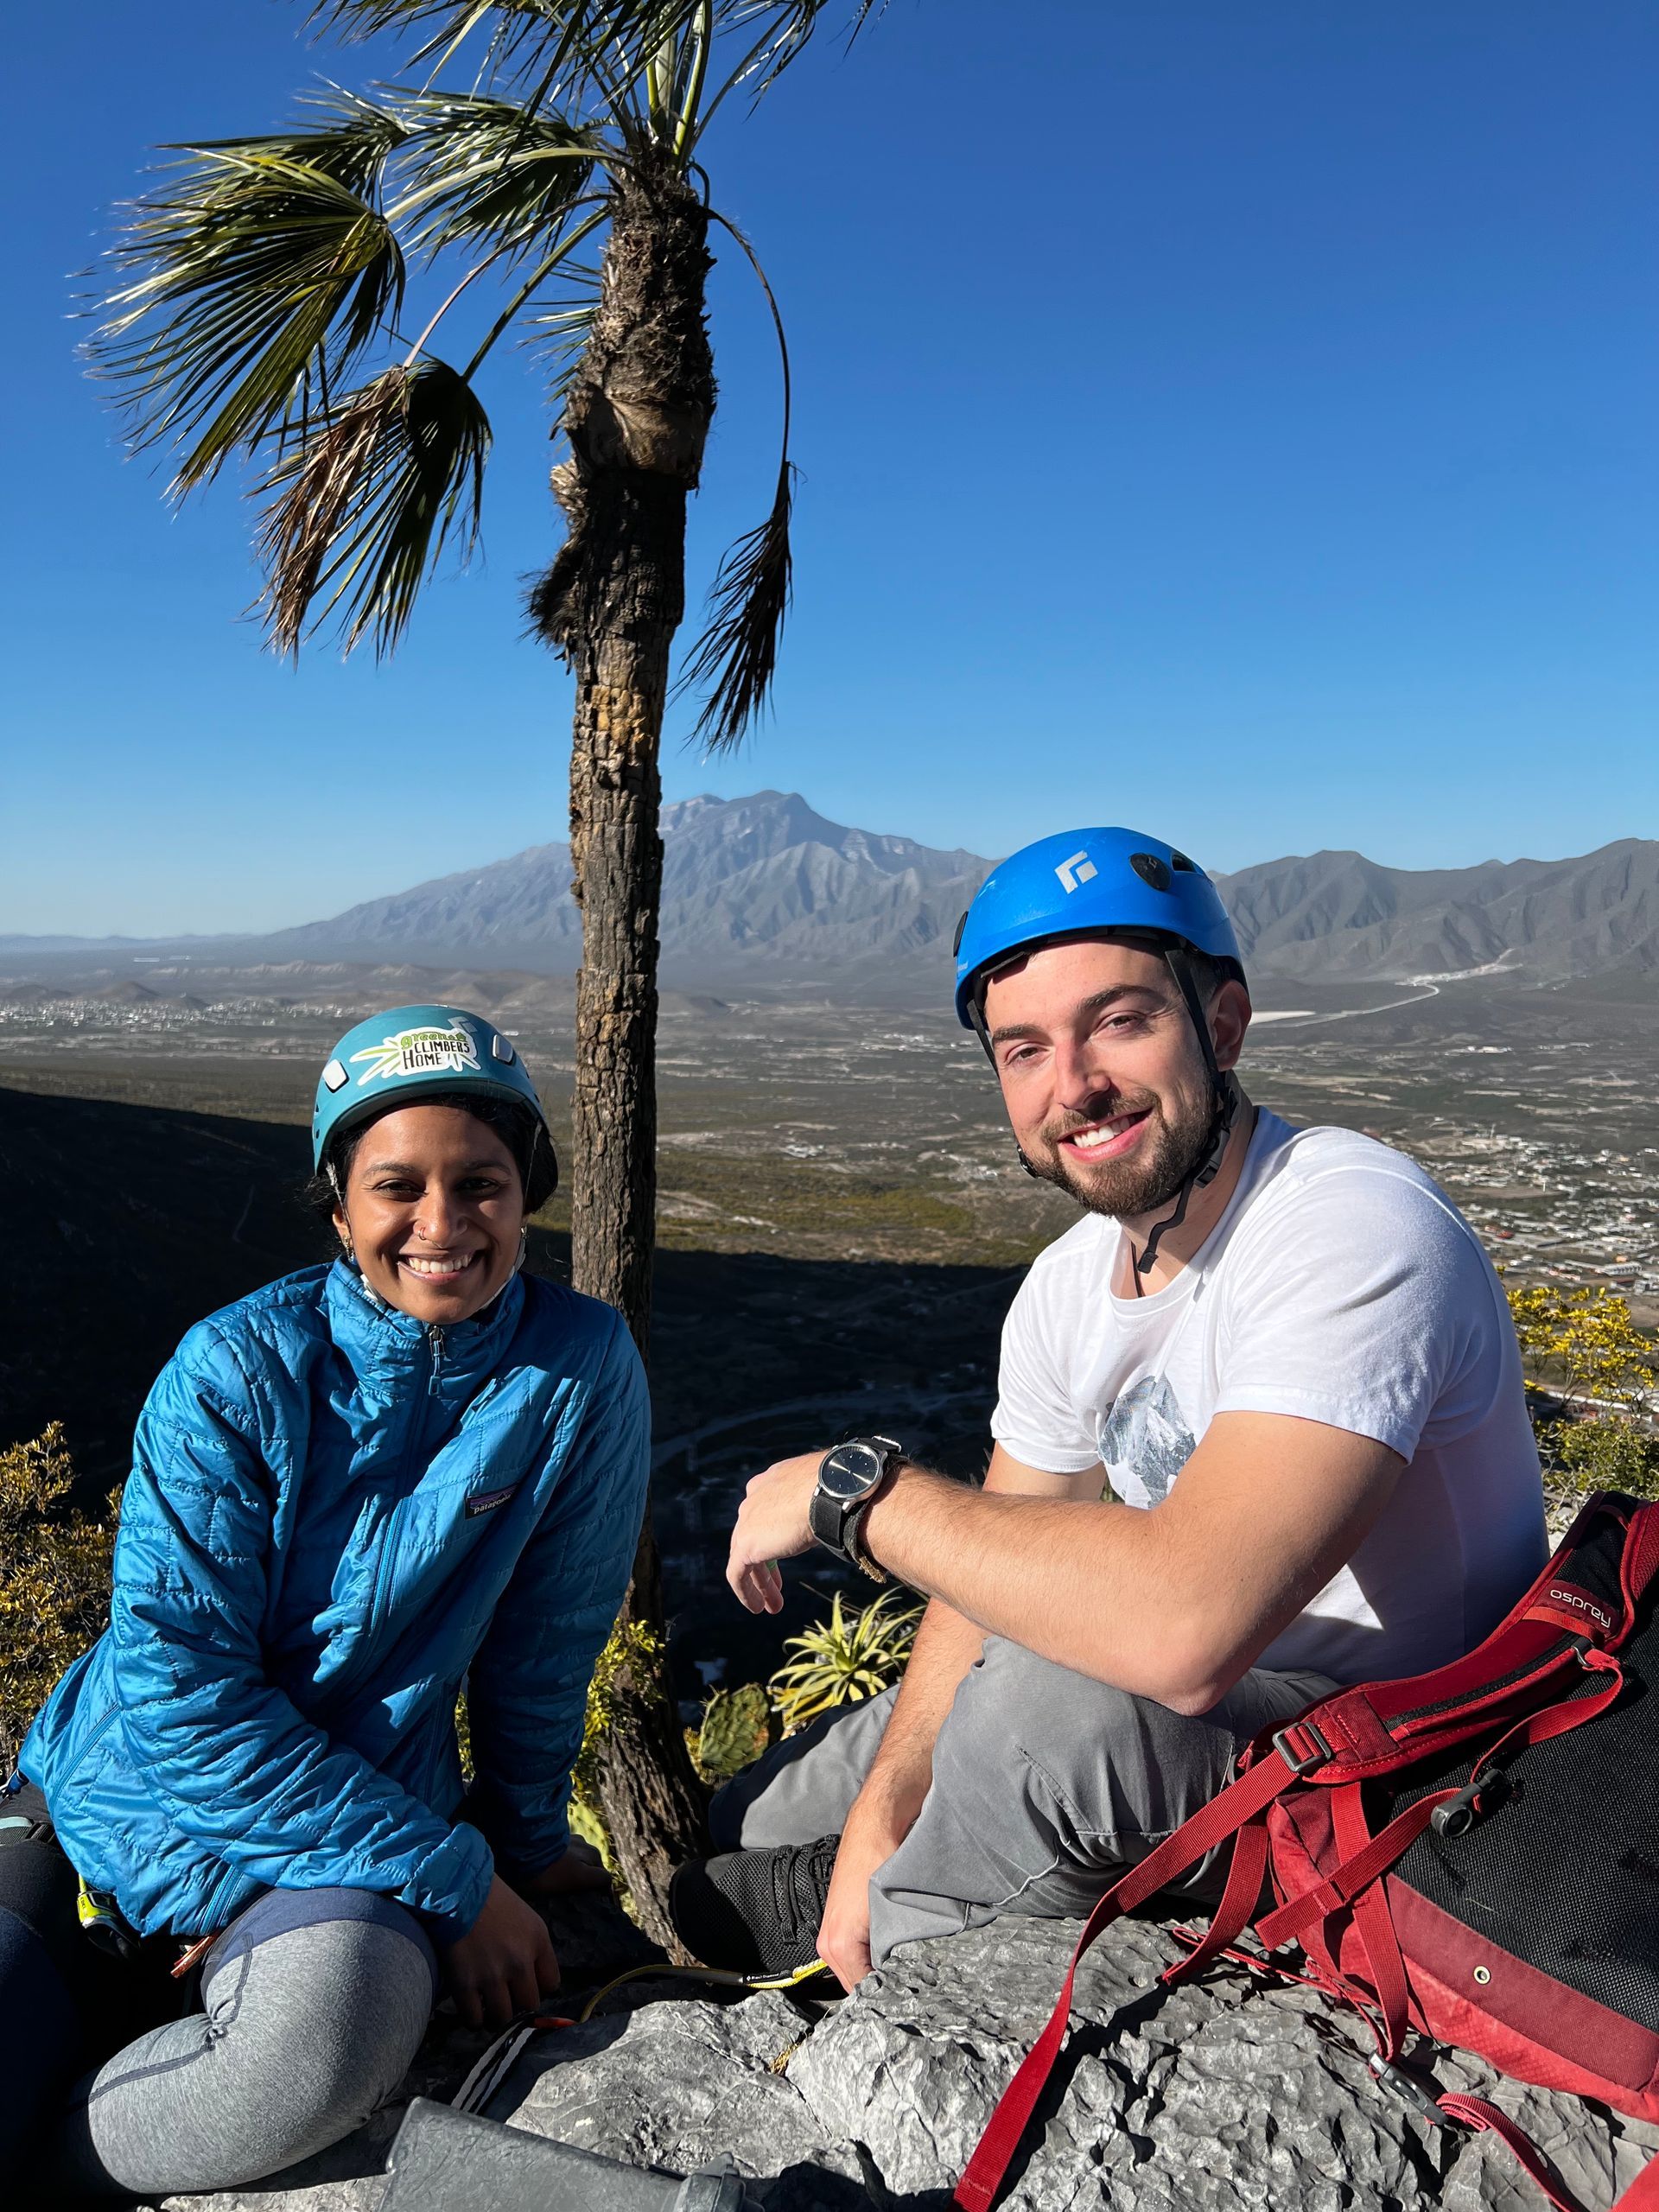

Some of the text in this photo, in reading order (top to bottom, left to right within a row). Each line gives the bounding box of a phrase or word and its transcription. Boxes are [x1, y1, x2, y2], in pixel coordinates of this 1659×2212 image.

[400, 1031, 448, 1050] green
[414, 1040, 470, 1053] CLIMBERS
[1549, 1589, 1611, 1629] osprey
